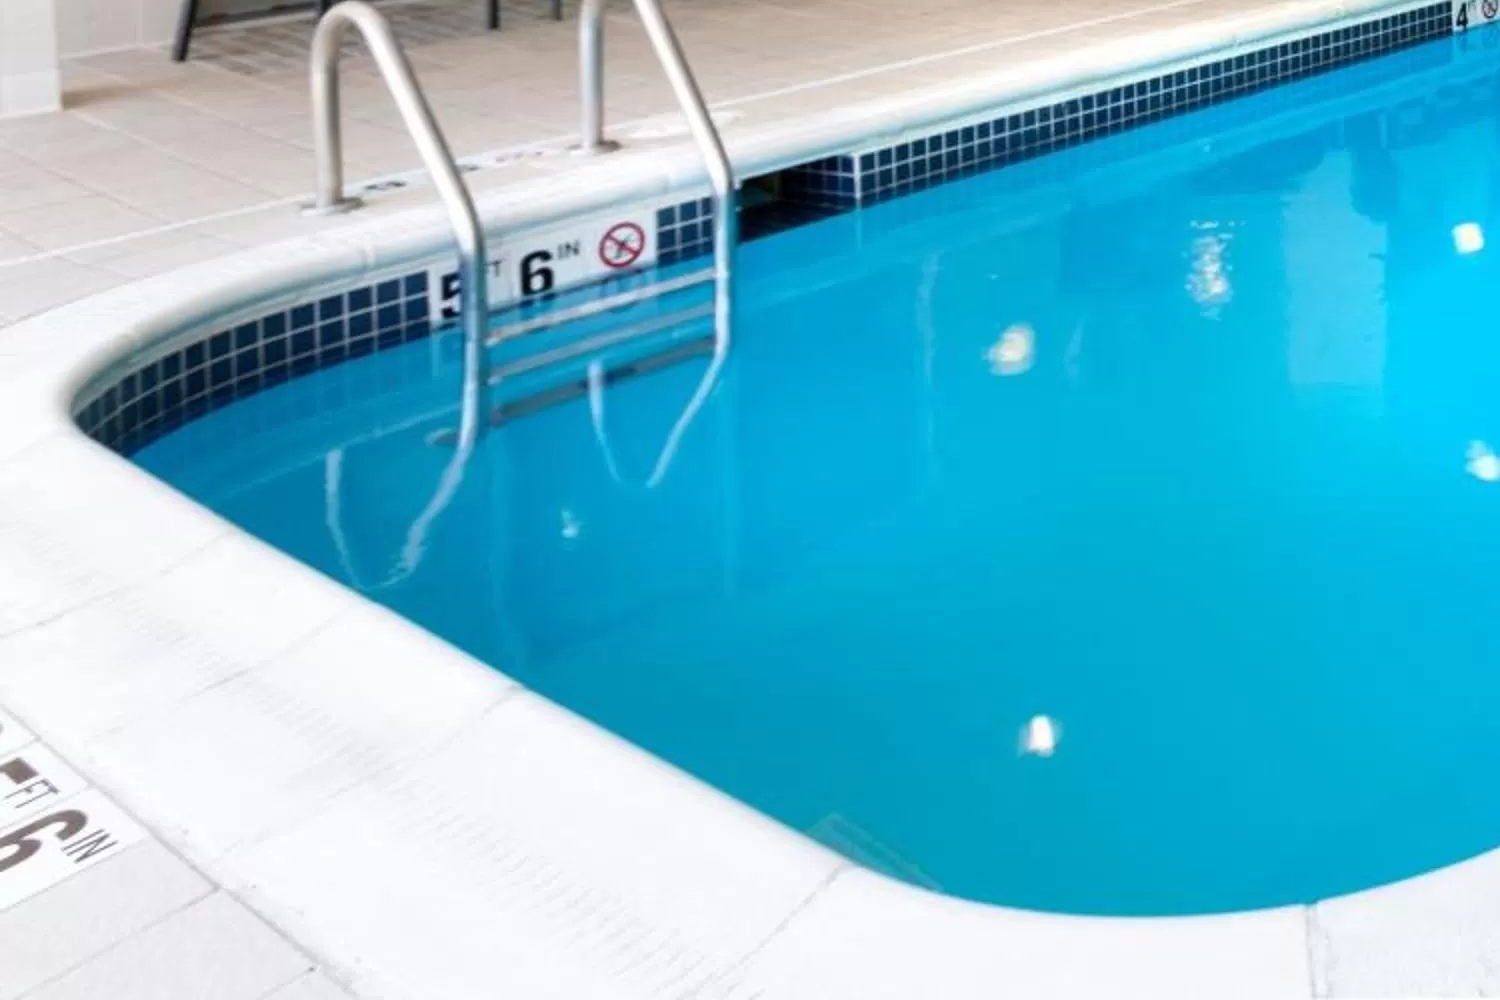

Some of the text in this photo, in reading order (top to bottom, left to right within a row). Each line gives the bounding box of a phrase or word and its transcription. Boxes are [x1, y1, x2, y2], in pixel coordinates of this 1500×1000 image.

[1455, 1, 1469, 31] 4
[519, 250, 554, 297] 6
[557, 239, 580, 261] IN
[3, 778, 59, 809] FT
[60, 828, 119, 864] IN
